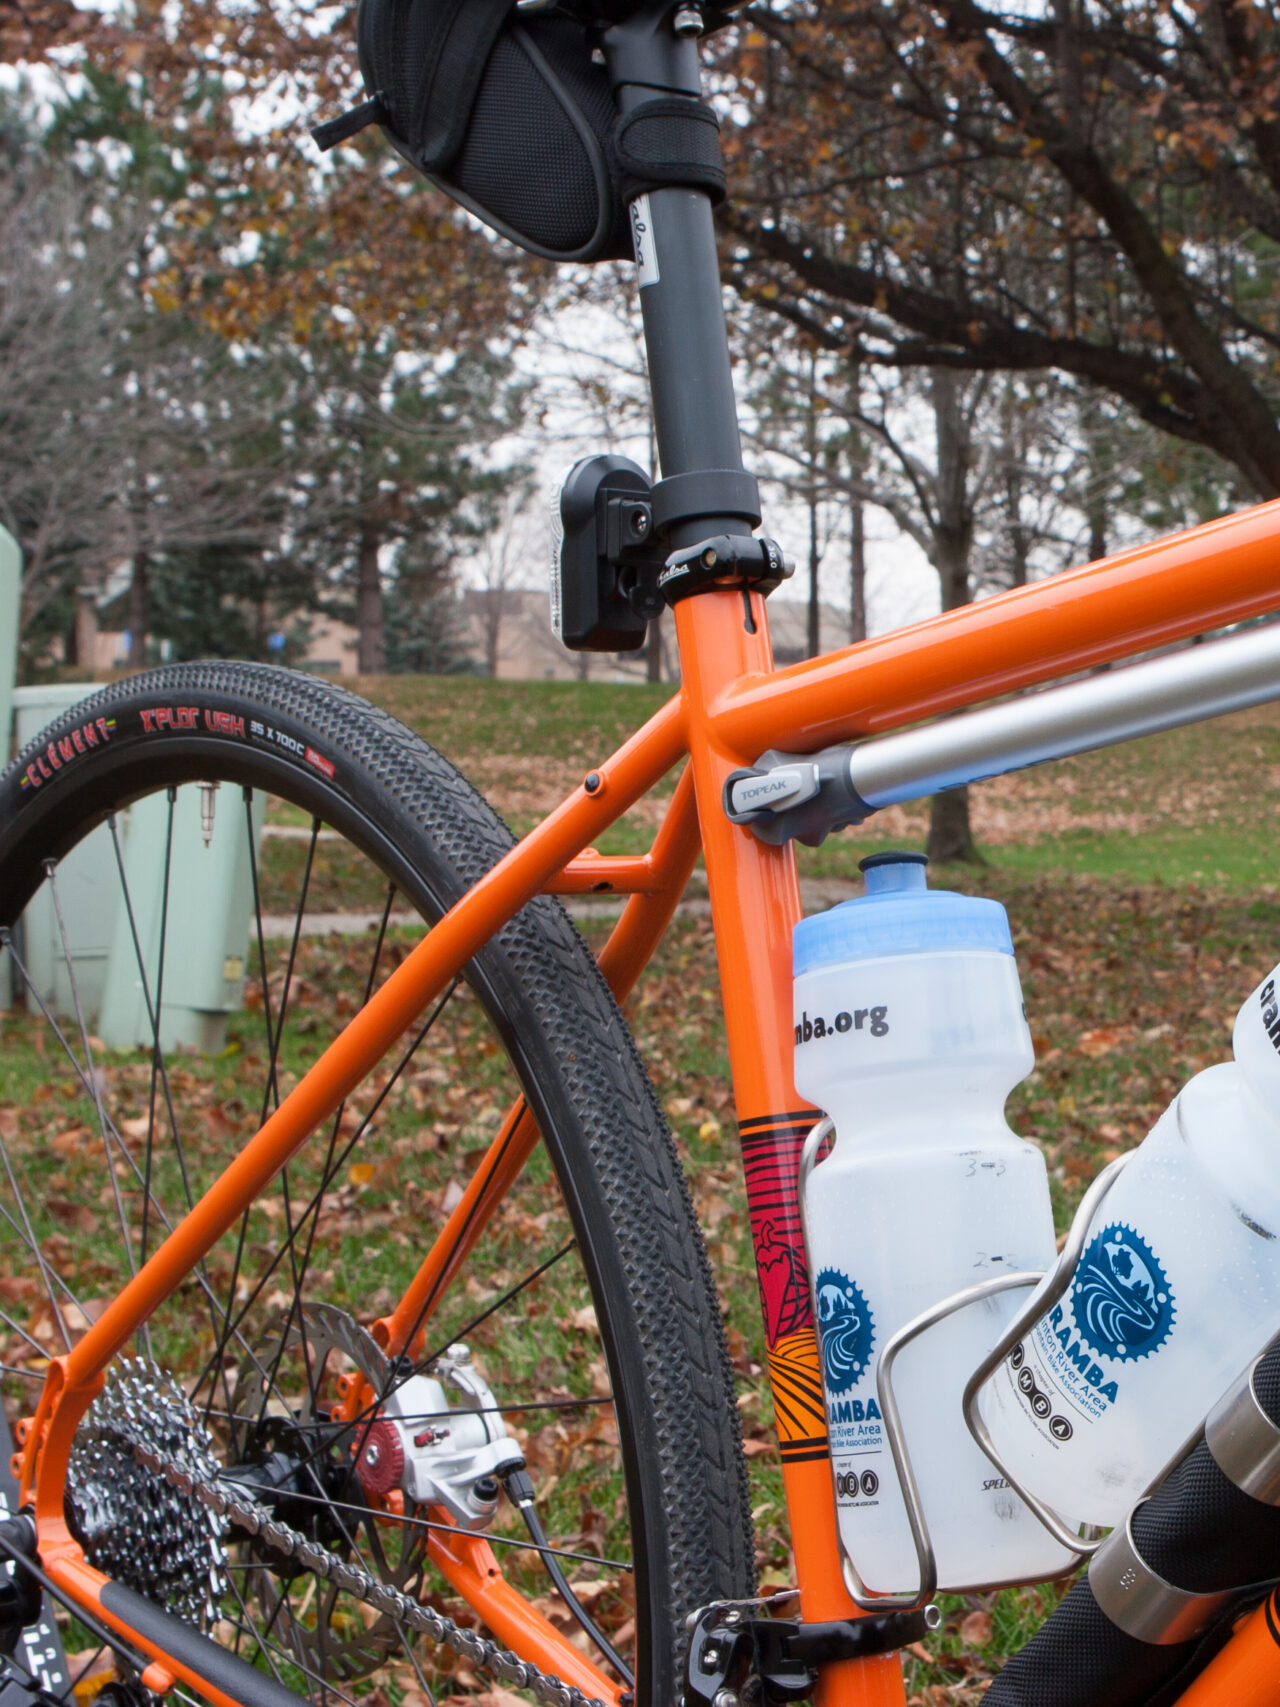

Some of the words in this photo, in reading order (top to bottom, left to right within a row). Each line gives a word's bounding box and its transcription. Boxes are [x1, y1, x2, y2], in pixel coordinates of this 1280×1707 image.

[204, 709, 247, 737] USH
[250, 720, 265, 735] 35
[275, 731, 305, 756] 700C
[740, 780, 787, 801] TOPEAK
[1056, 1351, 1080, 1383] River
[1080, 1385, 1107, 1411] Area
[1059, 1375, 1101, 1418] Association
[858, 1424, 881, 1435] Area
